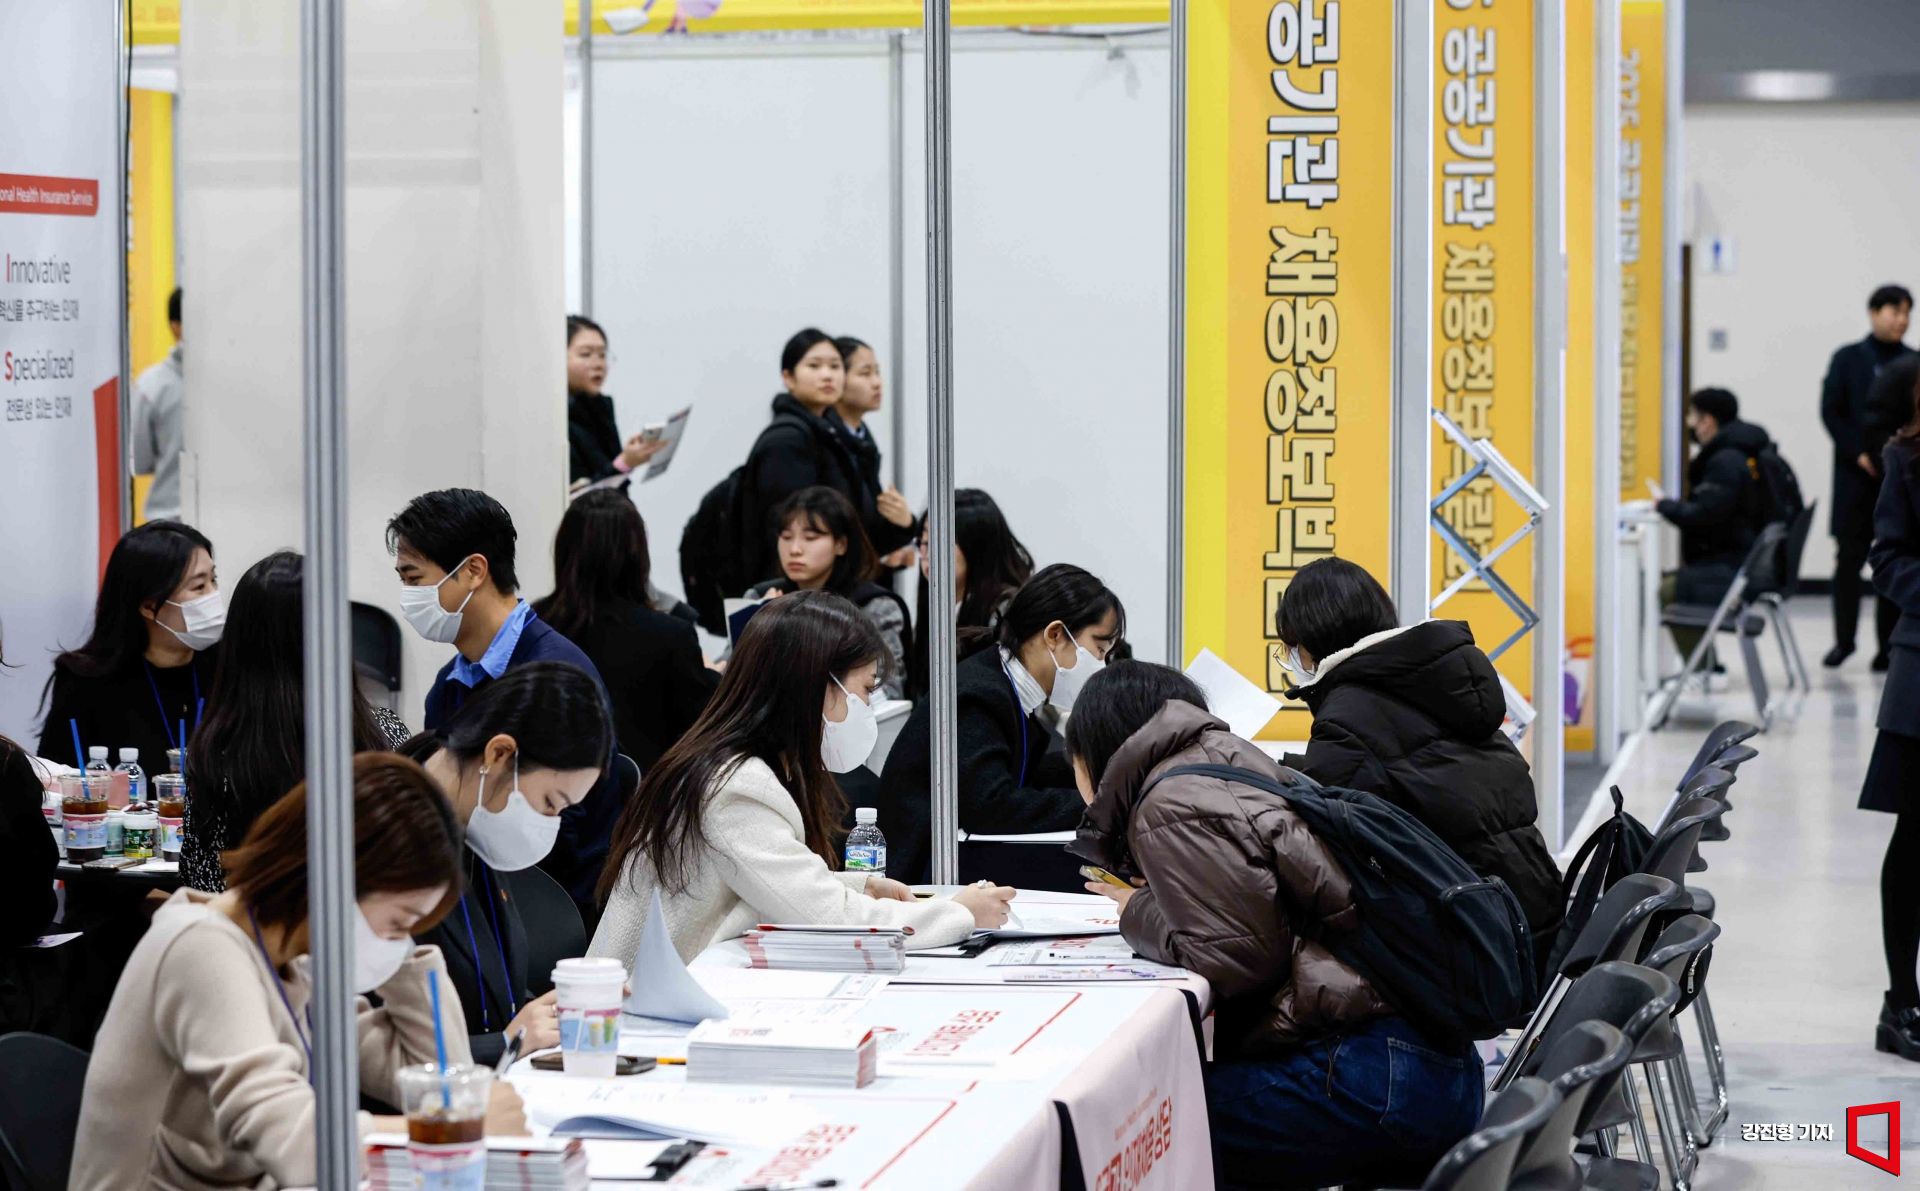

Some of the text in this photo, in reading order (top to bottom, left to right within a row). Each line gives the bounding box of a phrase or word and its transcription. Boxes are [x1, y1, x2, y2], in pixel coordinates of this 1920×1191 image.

[1442, 25, 1497, 230] 공공기관
[16, 187, 39, 204] Health
[40, 188, 70, 206] Insurance
[71, 190, 93, 207] Service
[6, 253, 72, 284] Innovative
[26, 299, 60, 322] 추구하는
[5, 350, 74, 386] Specialized
[6, 398, 33, 422] 전문성
[35, 397, 52, 420] 있는
[1264, 227, 1339, 710] 채용정보박
